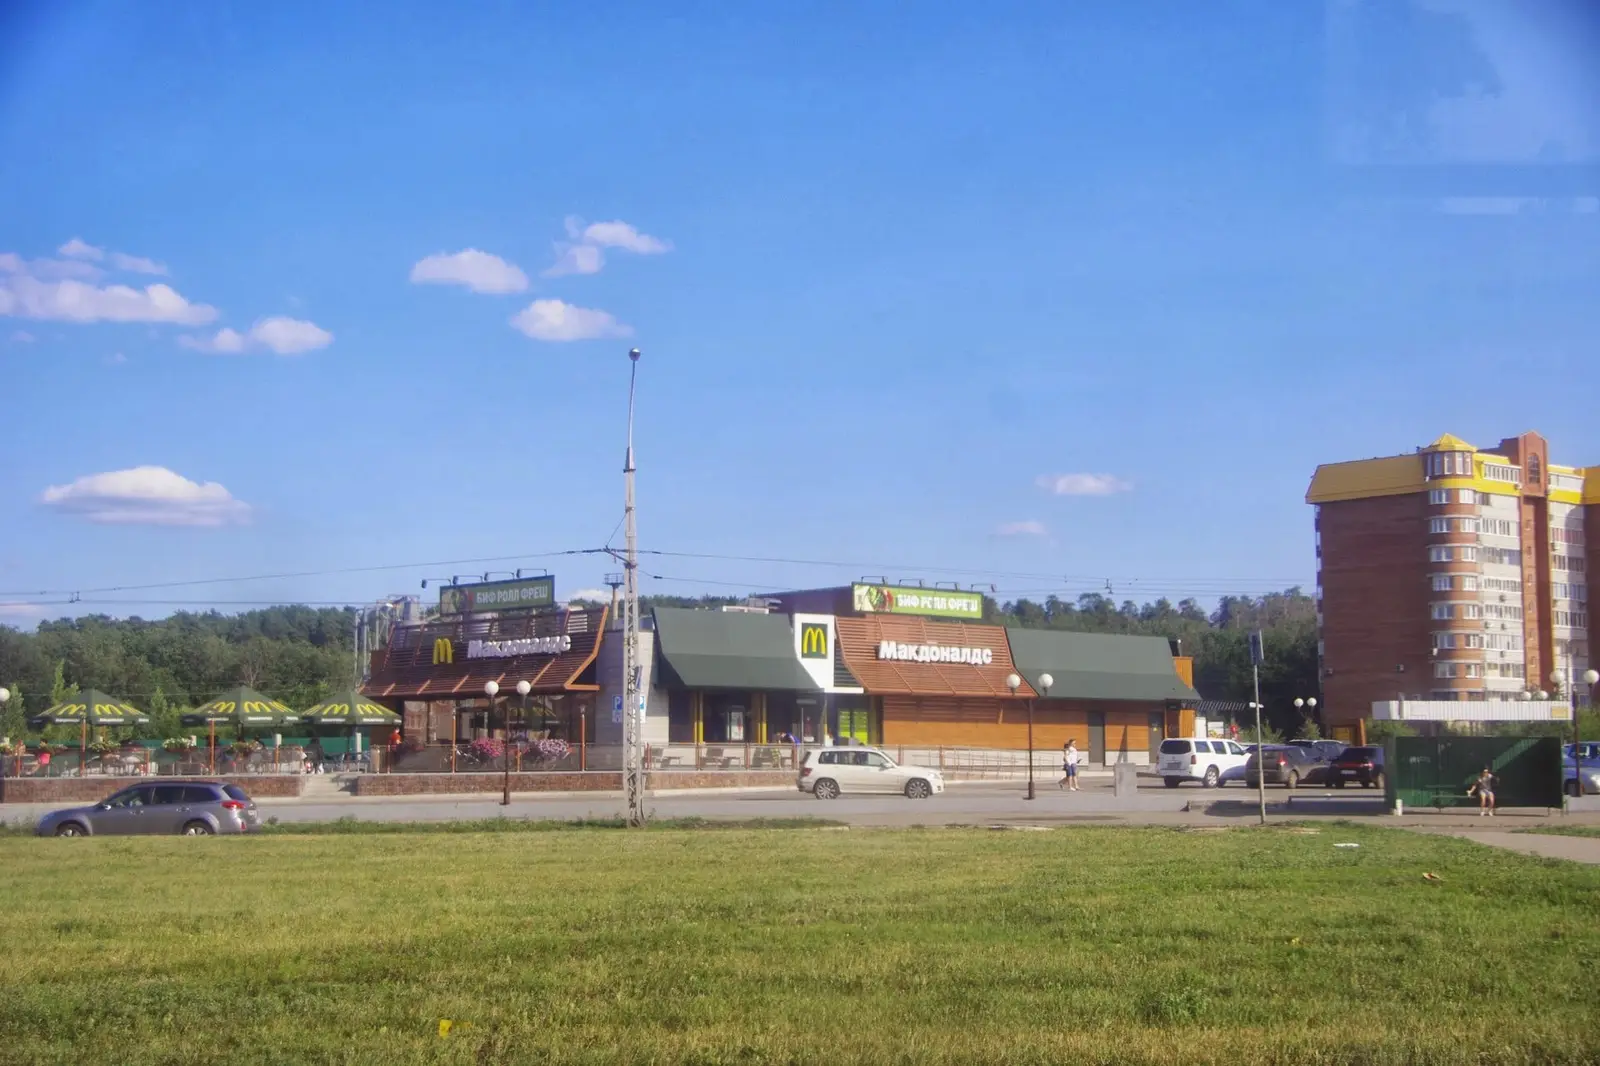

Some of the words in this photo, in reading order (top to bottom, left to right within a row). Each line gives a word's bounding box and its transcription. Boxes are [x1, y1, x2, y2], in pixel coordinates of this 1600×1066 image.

[476, 592, 496, 604] БИФ
[497, 588, 520, 602] РОЛЛ
[520, 585, 548, 599] ФРЕШ
[878, 640, 993, 665] Макдоналдс
